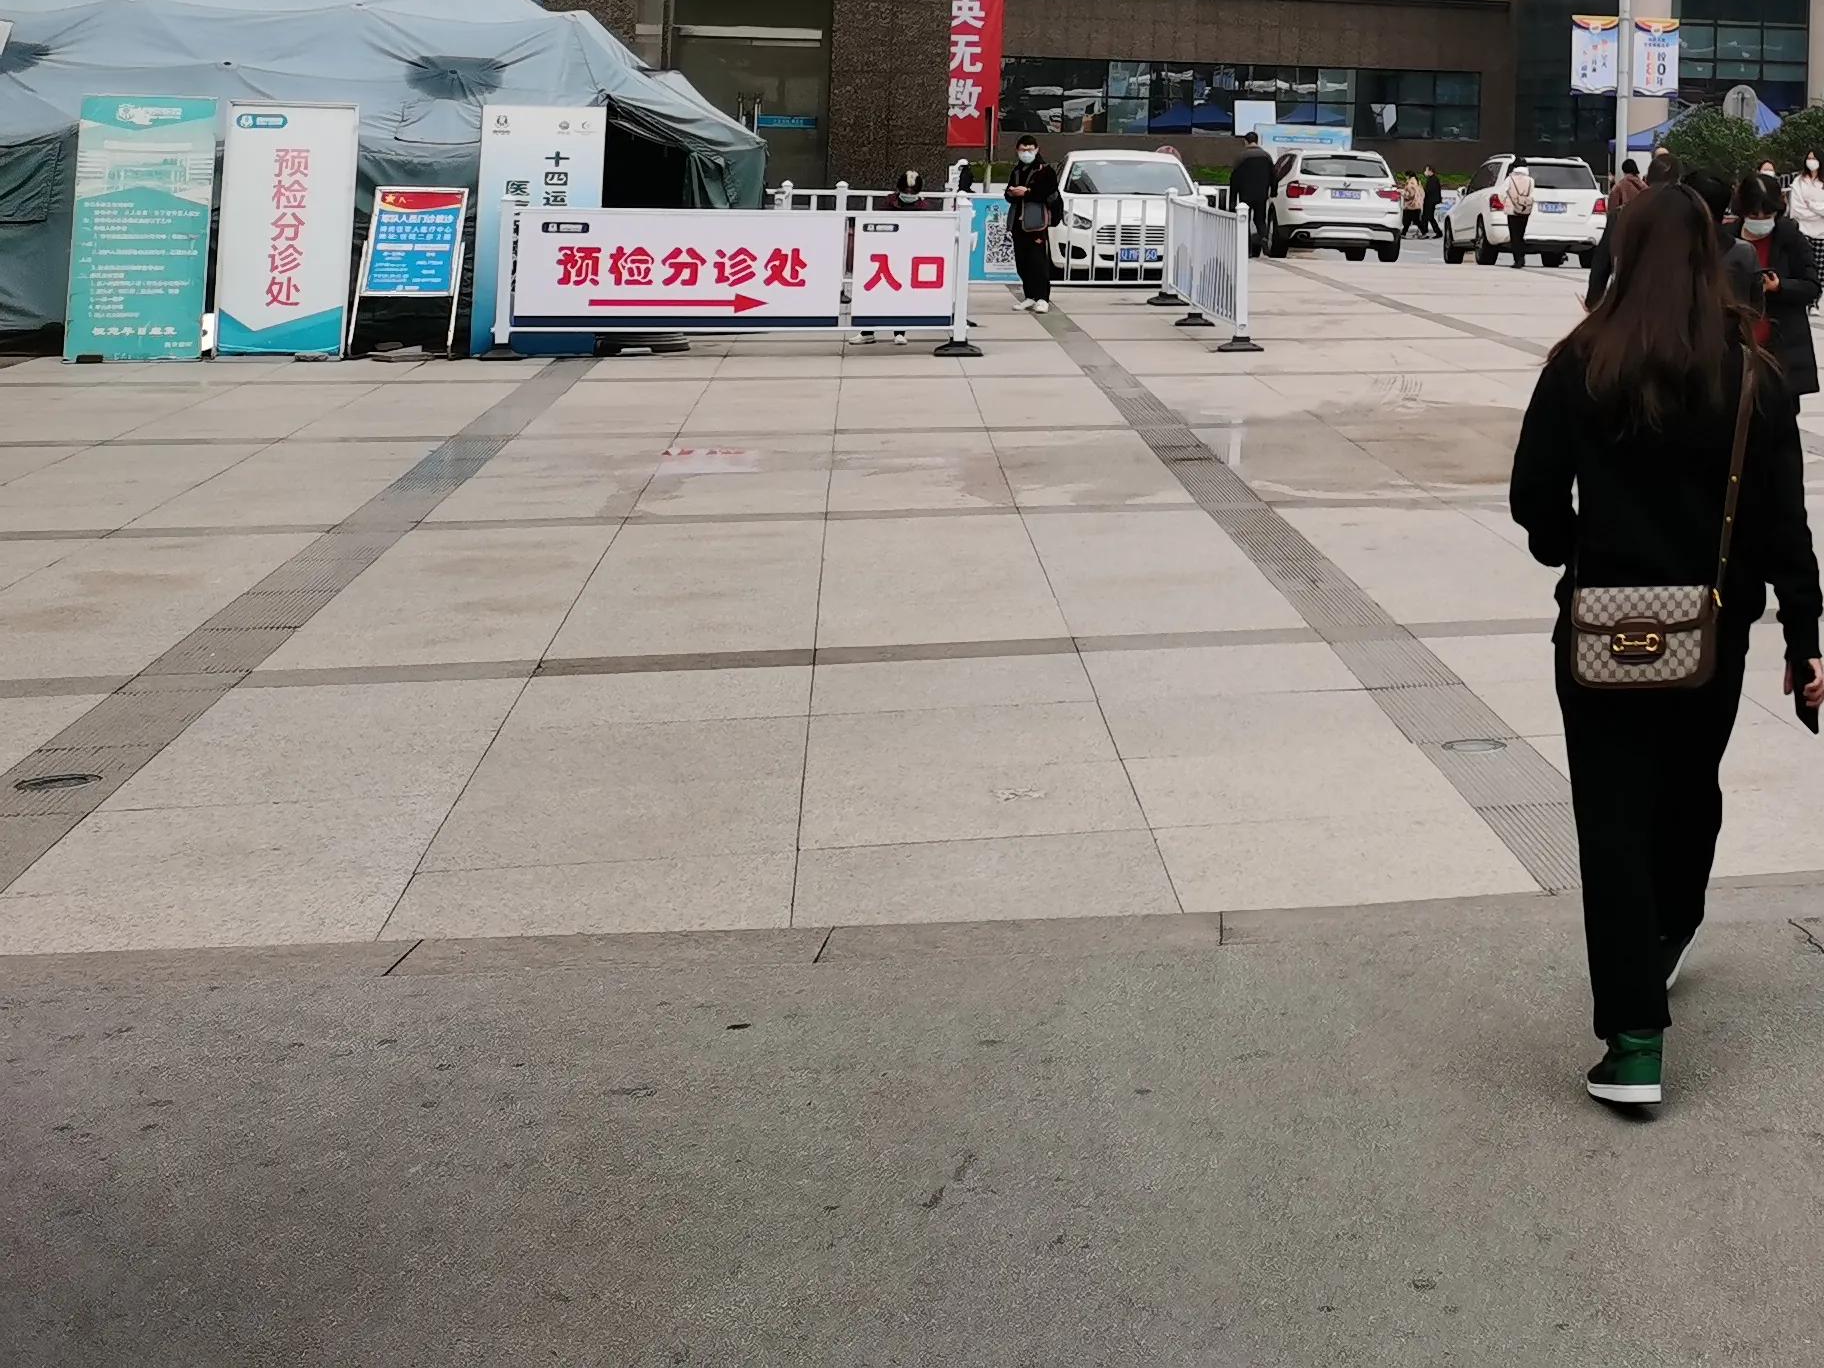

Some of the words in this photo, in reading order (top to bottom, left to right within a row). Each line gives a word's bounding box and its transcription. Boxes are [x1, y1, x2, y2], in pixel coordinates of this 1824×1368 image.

[265, 148, 310, 307] 预检分诊处
[557, 245, 808, 288] 预检分诊处
[863, 253, 945, 292] 入口
